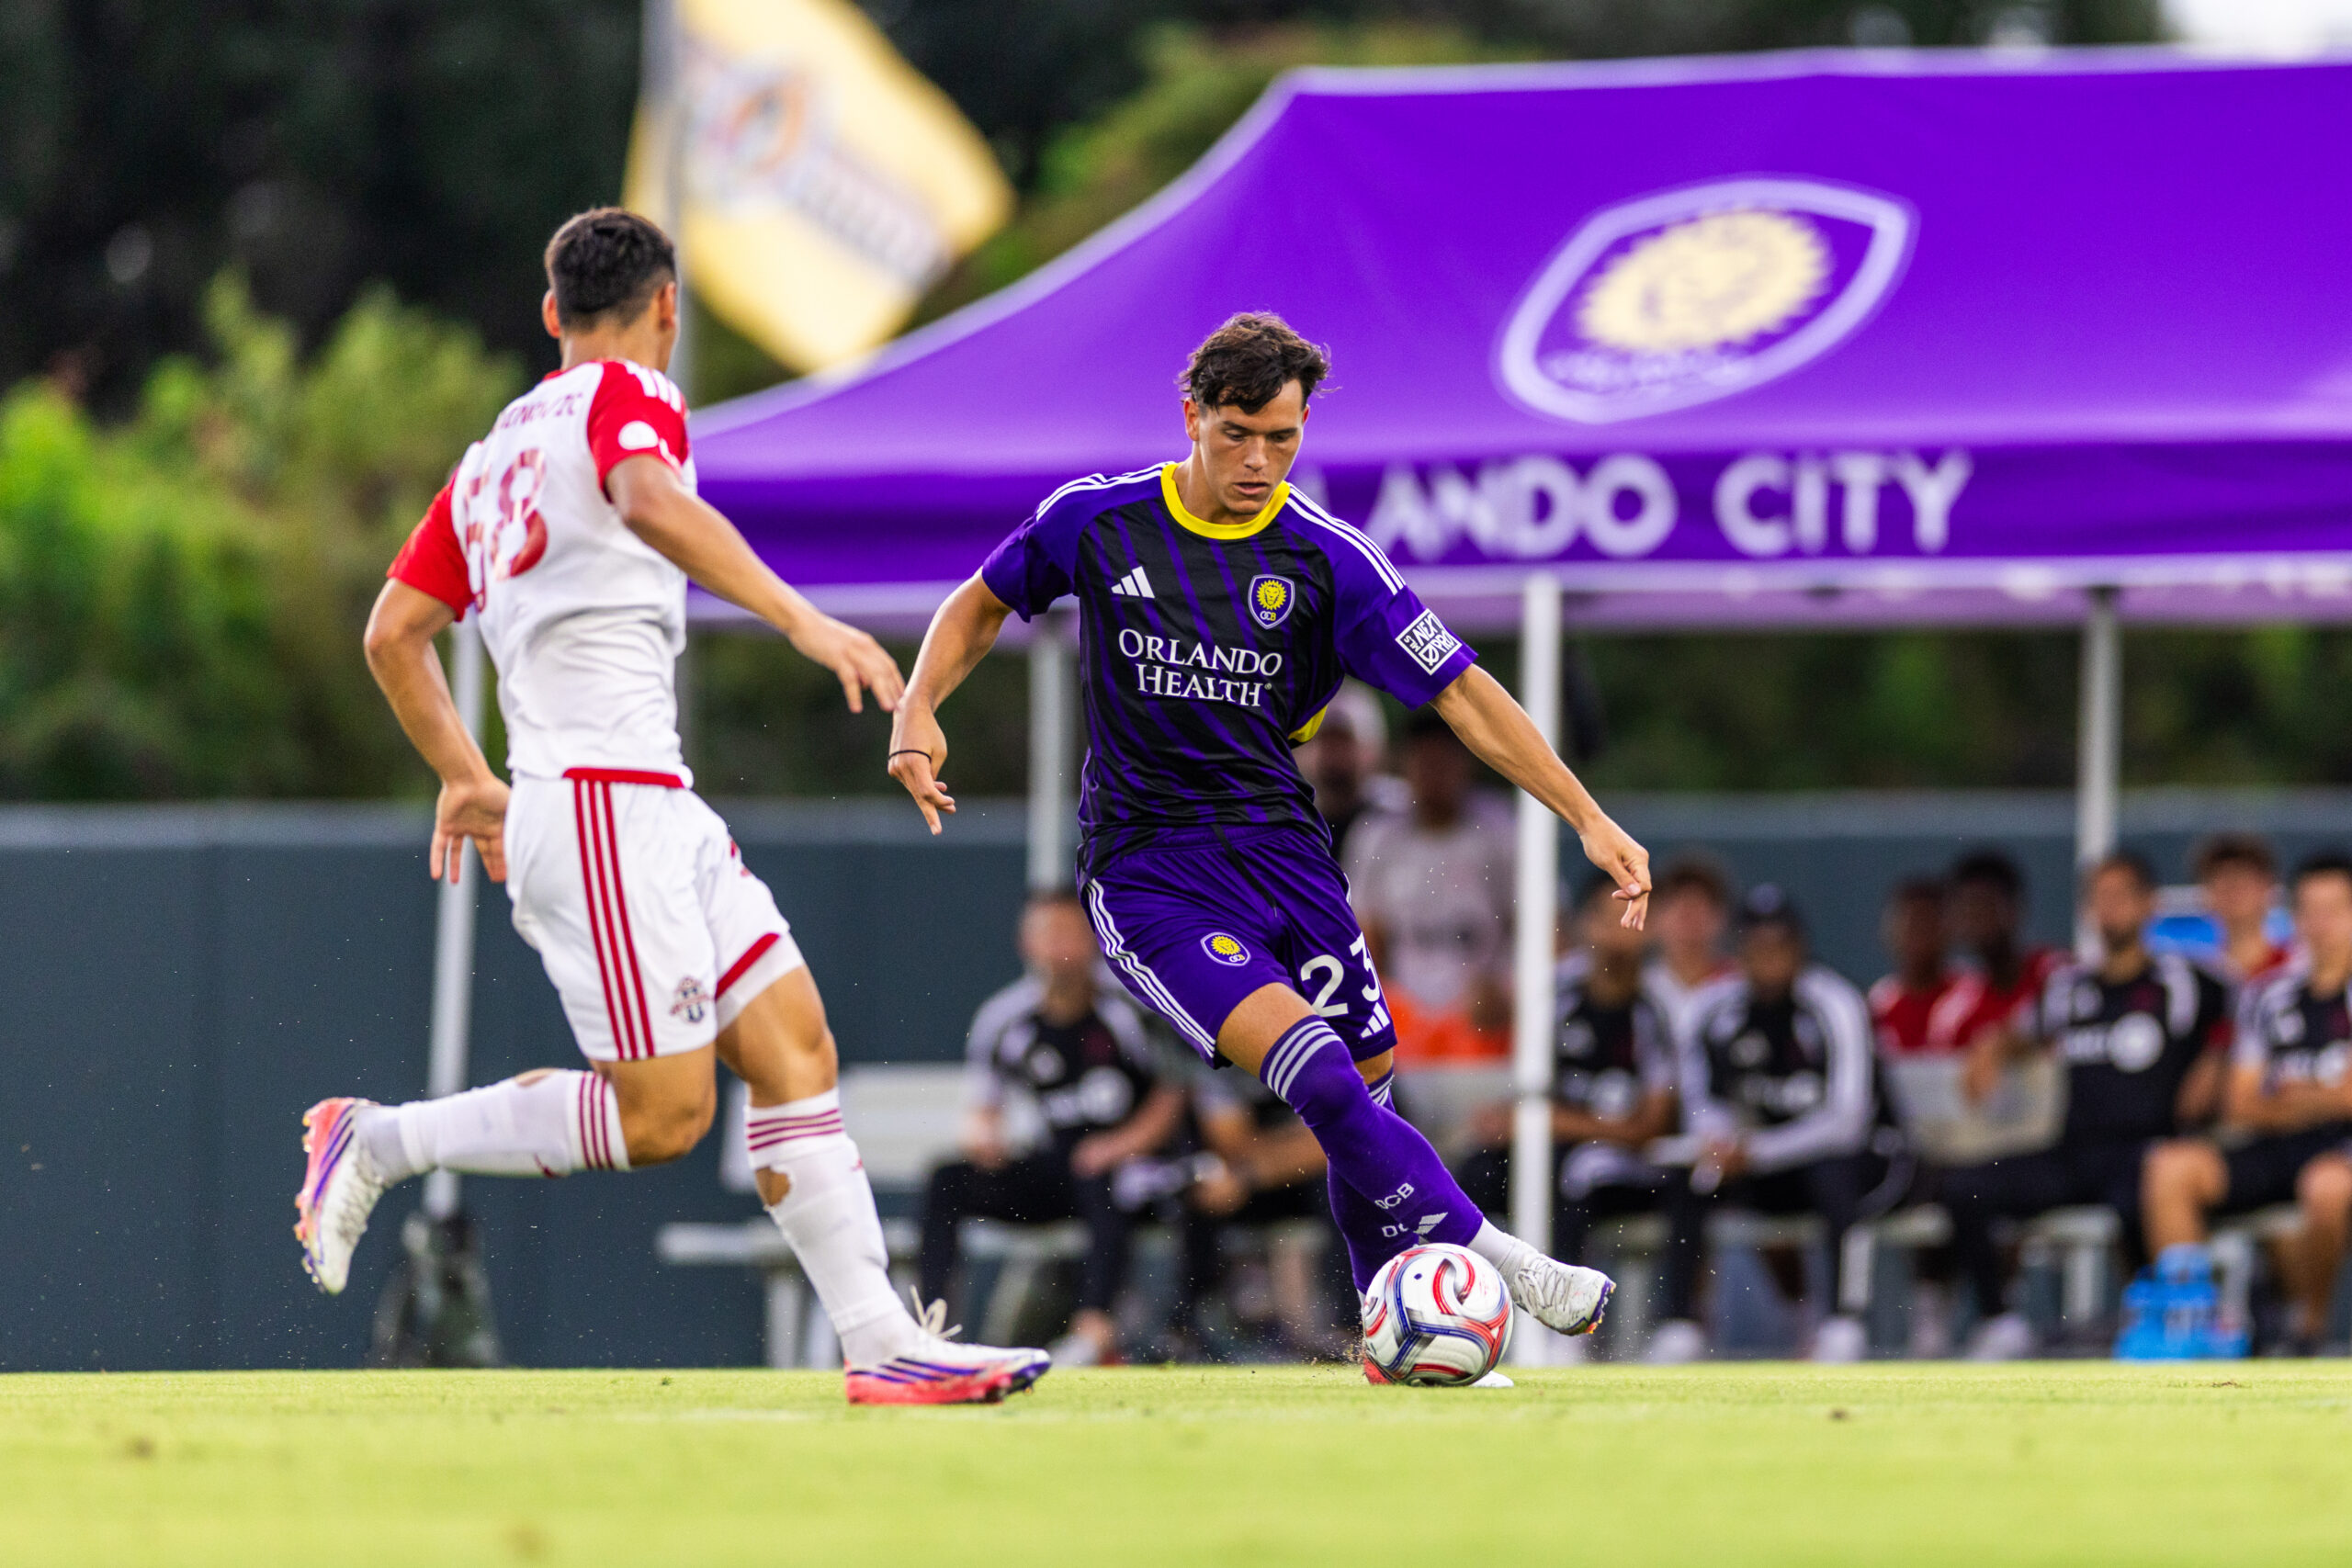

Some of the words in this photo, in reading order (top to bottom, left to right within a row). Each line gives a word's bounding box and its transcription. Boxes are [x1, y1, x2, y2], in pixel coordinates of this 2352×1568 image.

[1715, 455, 1973, 554] CITY
[1118, 628, 1283, 676] ORLANDO
[1300, 931, 1381, 1018] 23
